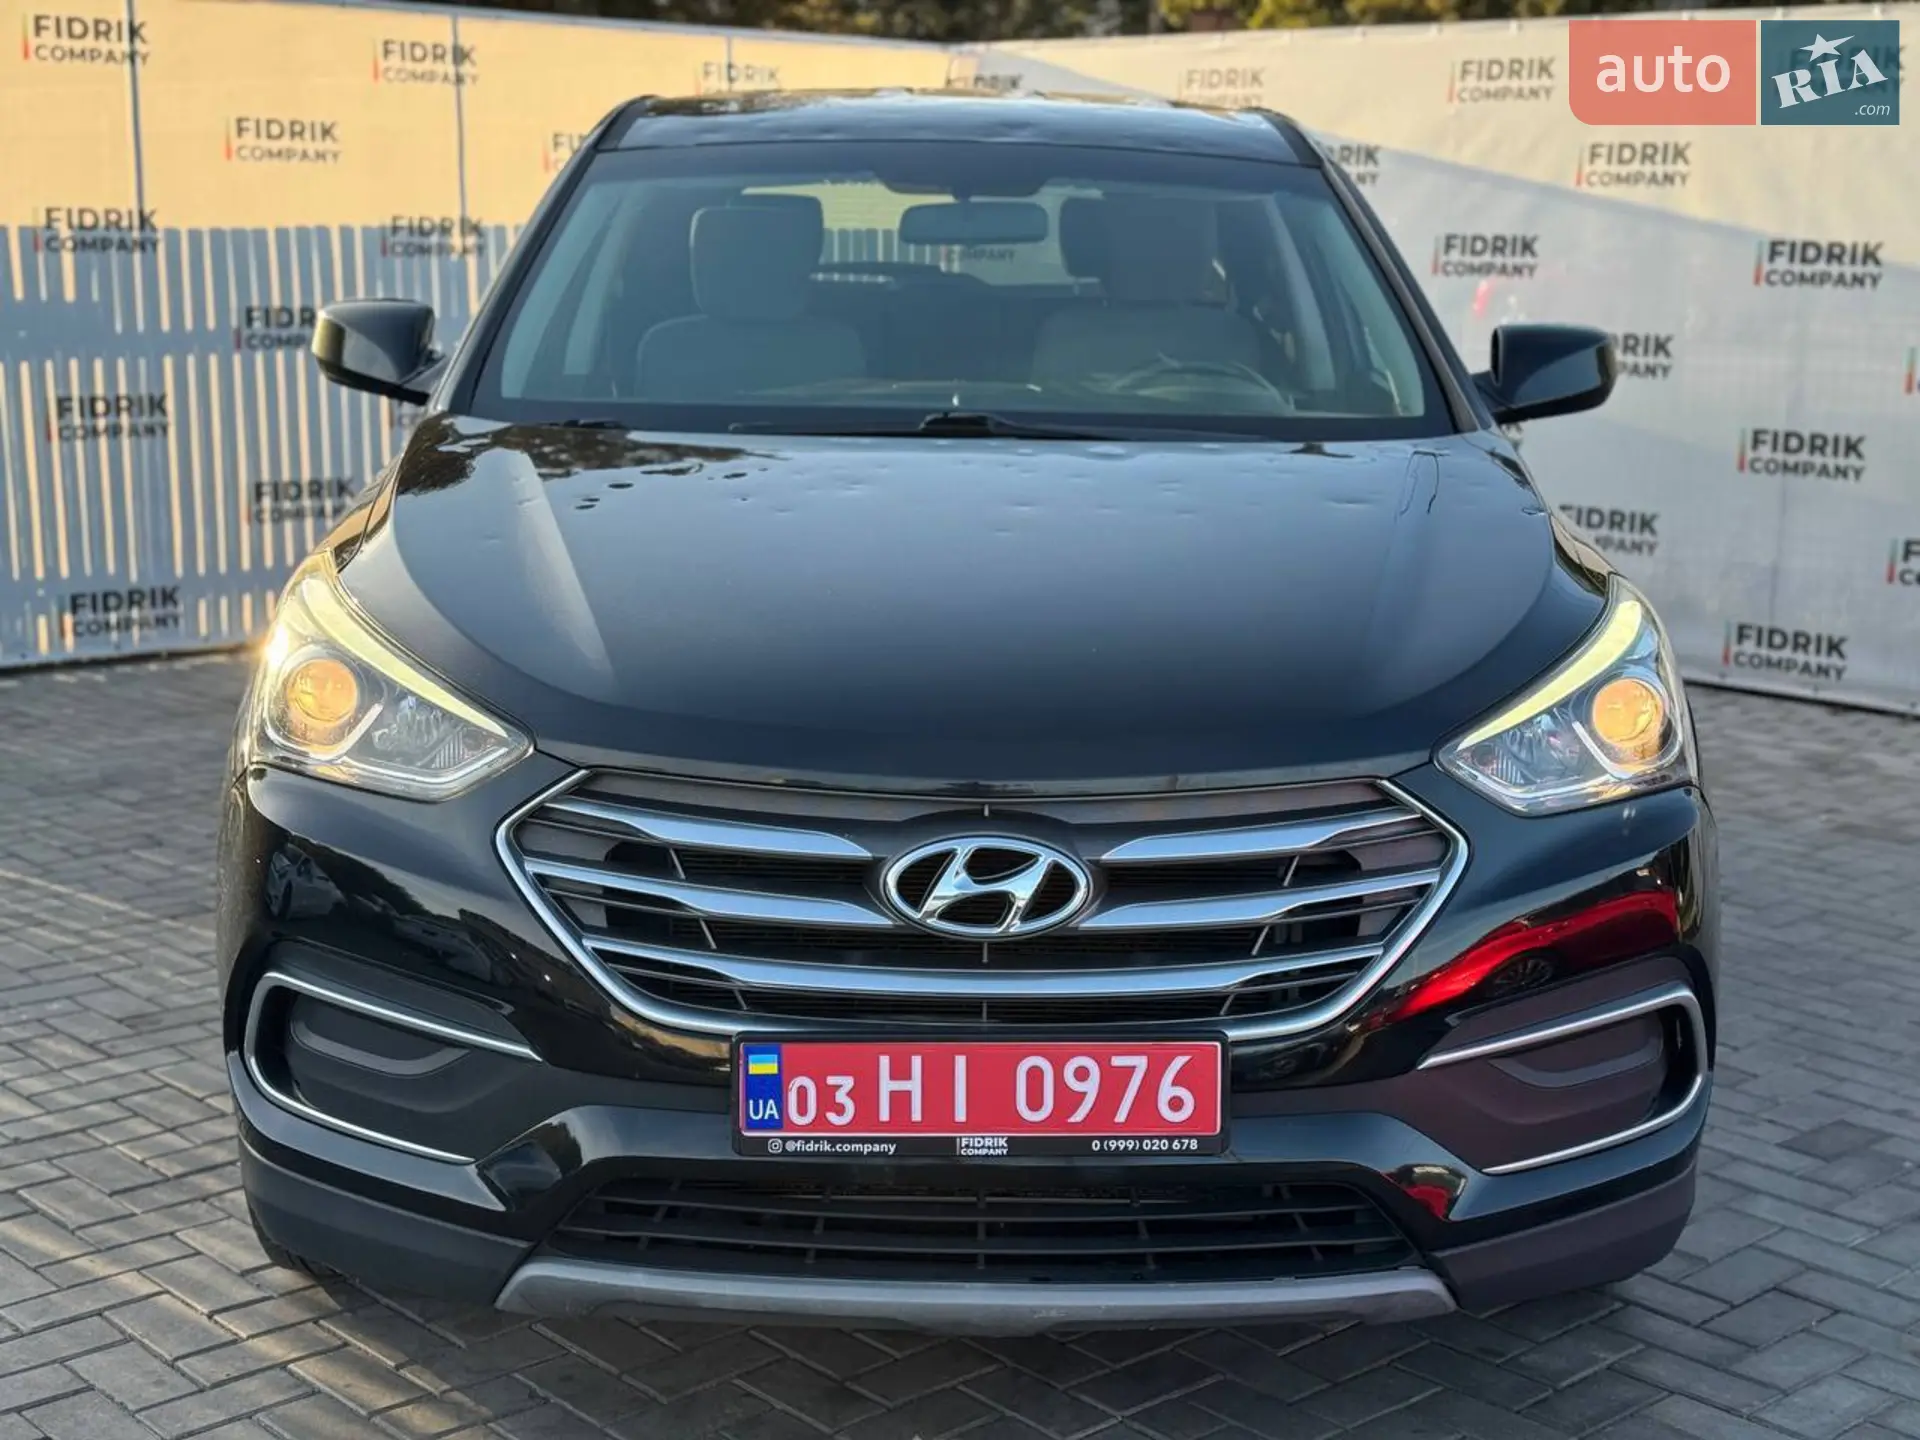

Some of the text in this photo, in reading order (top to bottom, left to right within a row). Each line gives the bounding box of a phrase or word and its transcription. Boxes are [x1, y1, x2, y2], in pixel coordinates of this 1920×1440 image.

[33, 15, 147, 44] FIDRIK
[33, 44, 150, 66] COMPANY
[382, 39, 477, 66] FIDRIK
[382, 65, 479, 86] COMPANY
[1186, 67, 1266, 90] FIDRIK
[1460, 57, 1555, 82] FIDRIK
[1457, 83, 1555, 104] COMPANY
[235, 117, 339, 143] FIDRIK
[236, 143, 341, 165] COMPANY
[1588, 142, 1692, 168] FIDRIK
[1585, 170, 1690, 189] COMPANY
[44, 207, 158, 232] FIDRIK
[391, 215, 484, 237] FIDRIK
[45, 234, 160, 254] COMPANY
[1443, 233, 1540, 259] FIDRIK
[1767, 240, 1885, 267] FIDRIK
[1440, 260, 1538, 279] COMPANY
[1764, 266, 1884, 291] COMPANY
[57, 394, 169, 421] FIDRIK
[57, 420, 171, 444] COMPANY
[1749, 428, 1867, 461] FIDRIK
[1747, 455, 1867, 483] COMPANY
[255, 477, 356, 503] FIDRIK
[69, 586, 182, 615] FIDRIK
[70, 612, 182, 638] COMPANY
[1735, 621, 1849, 660] FIDRIK
[1733, 649, 1848, 683] COMPANY
[748, 1099, 780, 1121] UA
[787, 1075, 856, 1127] 03
[1015, 1055, 1196, 1123] 0976
[785, 1139, 897, 1155] @fidrik.company
[960, 1137, 1009, 1148] FIDRIK
[960, 1148, 1008, 1156] COMPANY
[1091, 1139, 1199, 1151] 0 (999) 020 678
